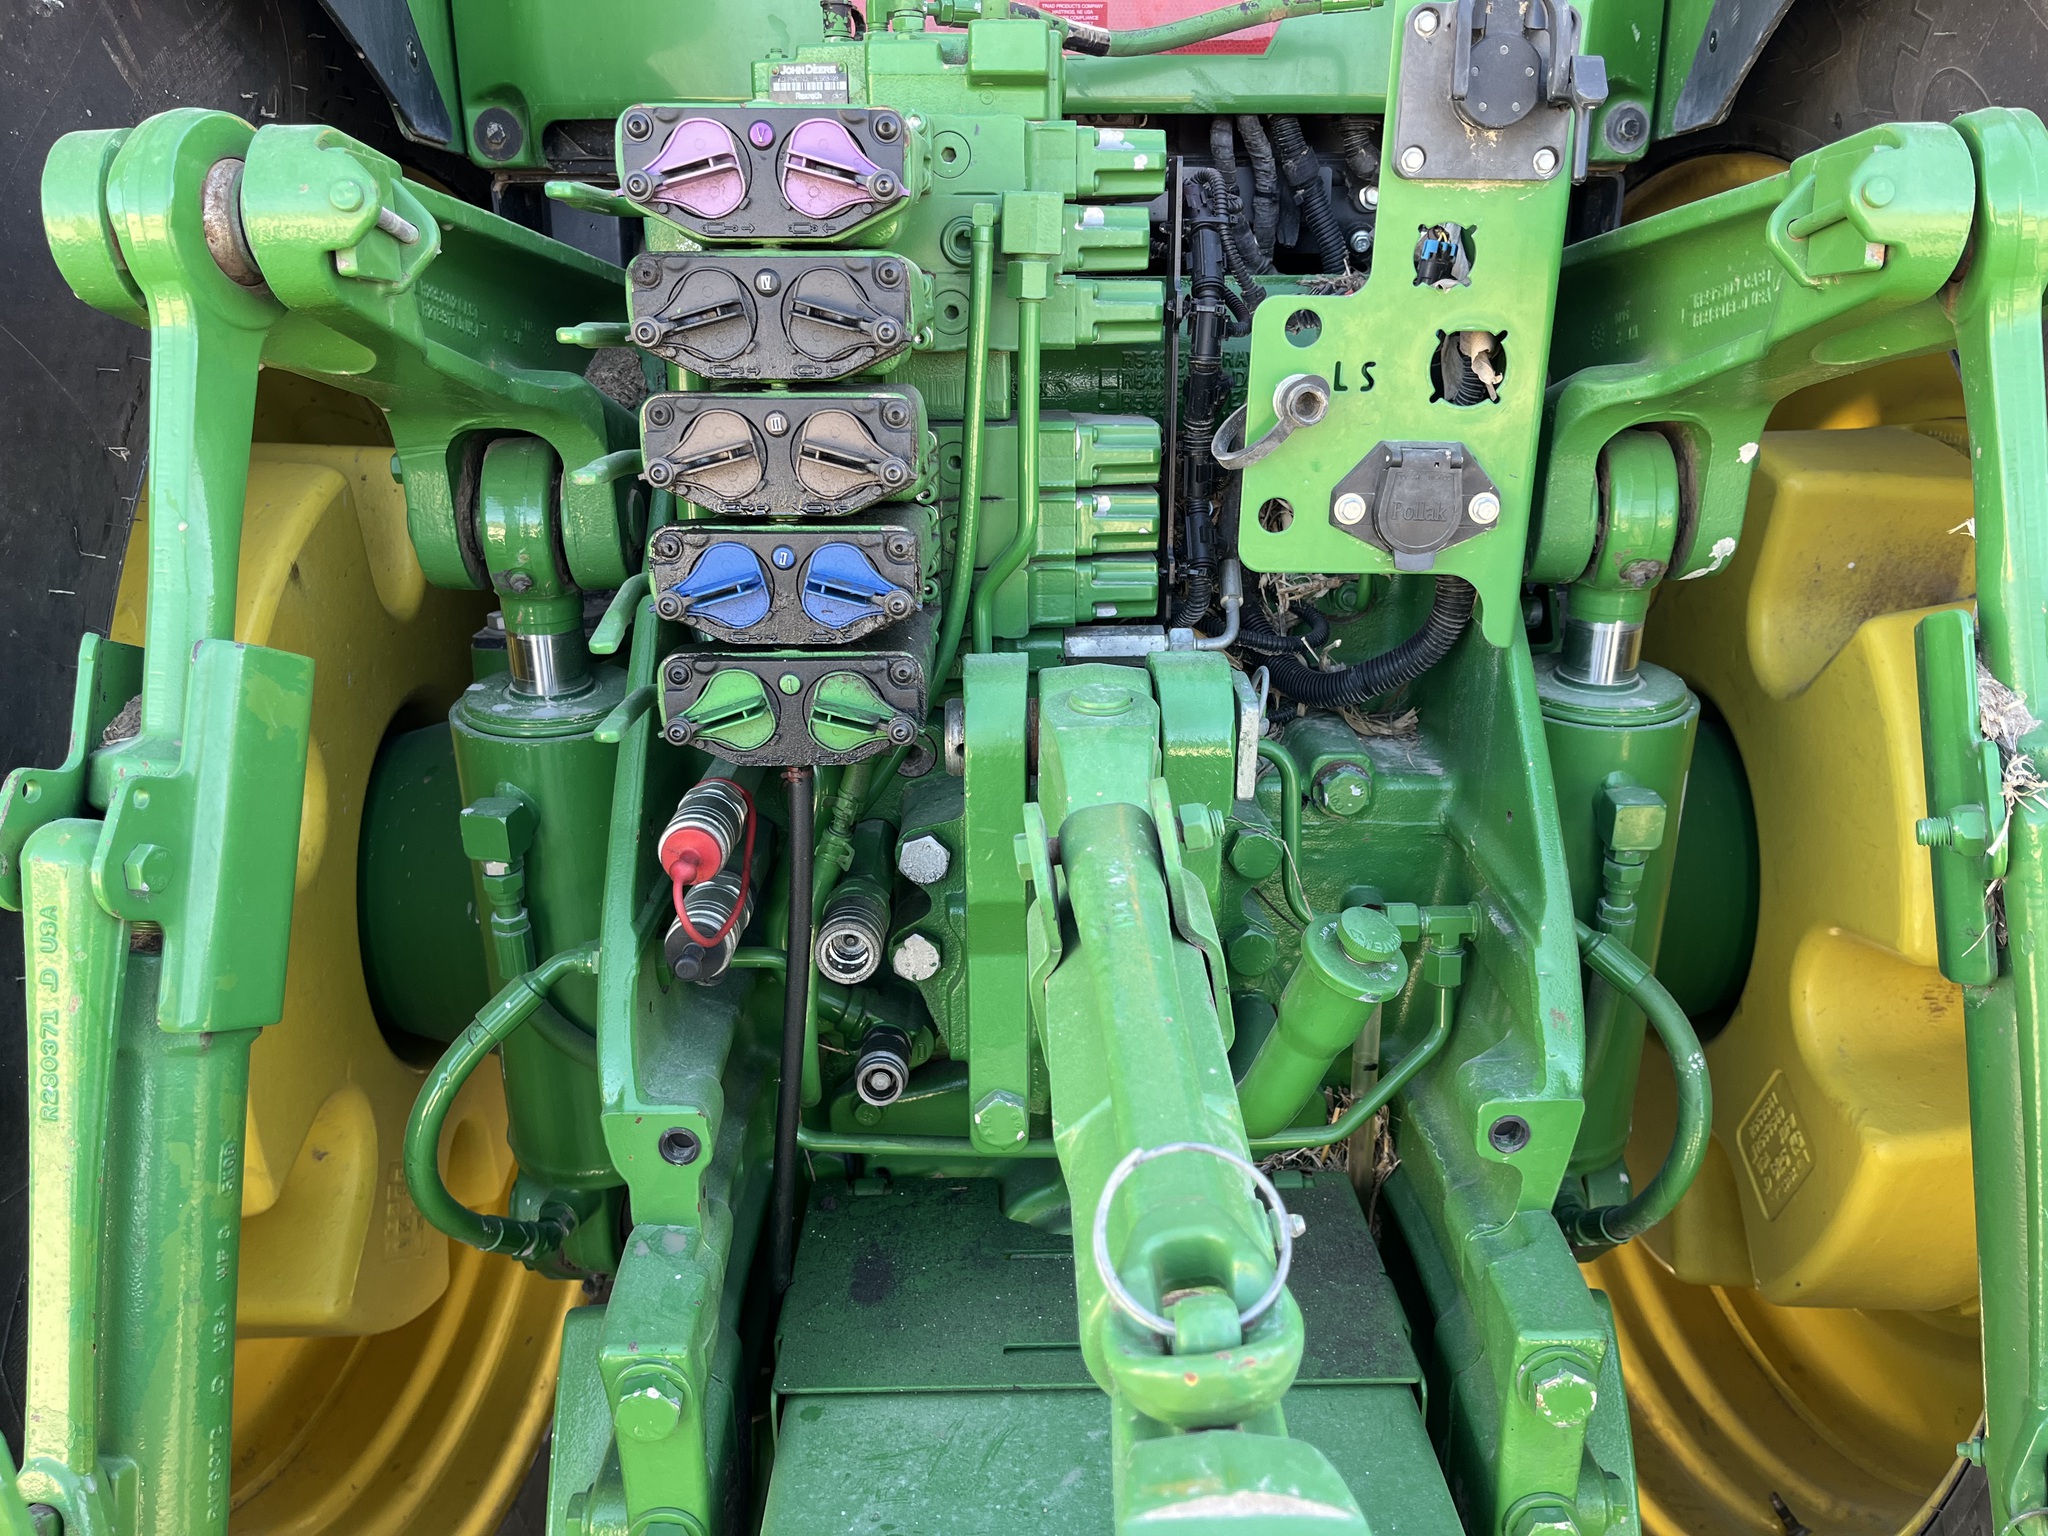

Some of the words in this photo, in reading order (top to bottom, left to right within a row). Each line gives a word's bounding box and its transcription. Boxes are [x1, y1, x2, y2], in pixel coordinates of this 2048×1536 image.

[780, 65, 804, 75] JOHN
[805, 64, 837, 74] DEERE
[757, 127, 766, 142] V
[760, 275, 772, 290] IV
[1390, 501, 1448, 522] Pollak
[40, 905, 58, 954] USA
[40, 967, 58, 993] D
[40, 1009, 59, 1122] R280371
[212, 1302, 228, 1353] USA
